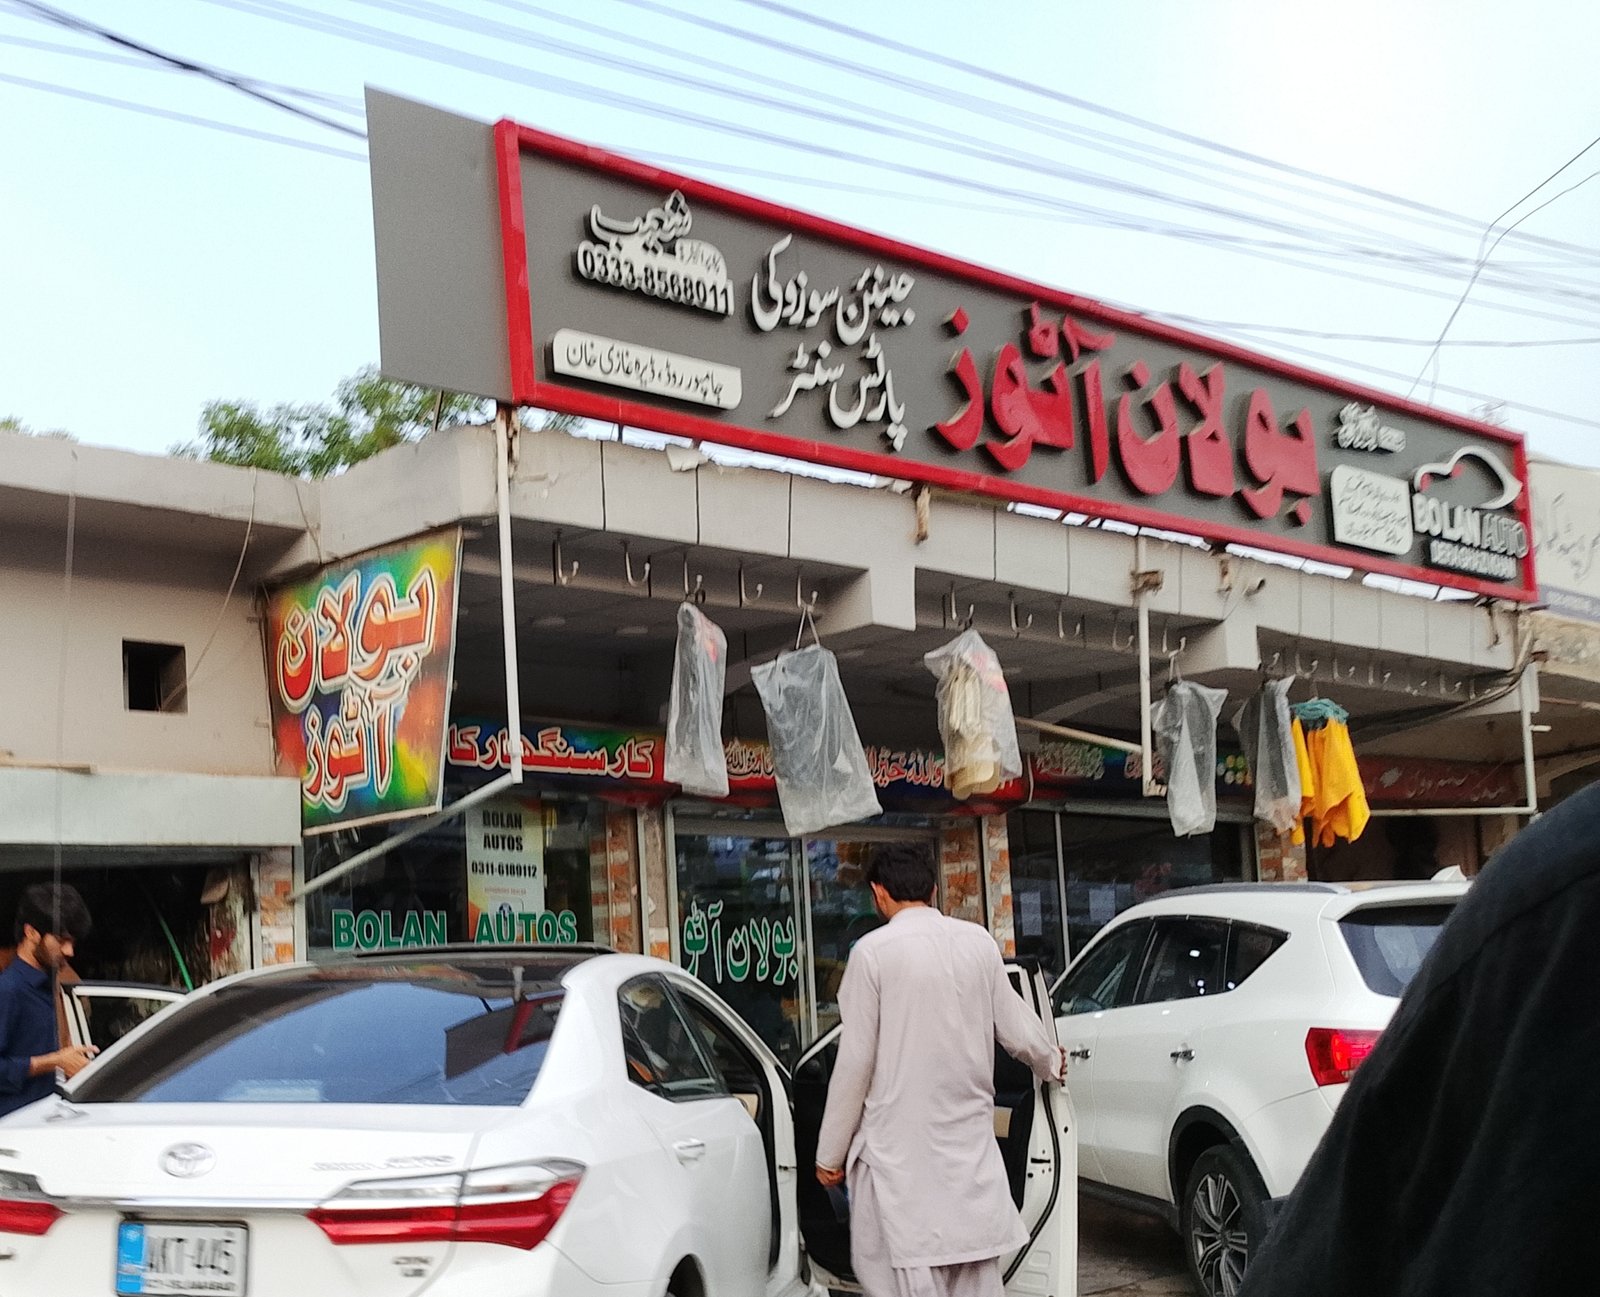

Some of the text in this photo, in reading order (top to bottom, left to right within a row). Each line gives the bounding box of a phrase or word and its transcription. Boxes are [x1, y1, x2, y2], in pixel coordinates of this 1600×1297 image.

[752, 233, 839, 332] سوزوکی
[566, 341, 597, 367] خان
[829, 332, 908, 451] پارٹس
[929, 302, 1116, 485] آٹوز
[1117, 361, 1322, 527] بولان
[277, 568, 437, 714] بولان
[483, 810, 522, 830] BOLAN
[483, 834, 523, 852] AUTOS
[332, 909, 577, 952] BOLAN AUTOS
[726, 915, 799, 986] بولان
